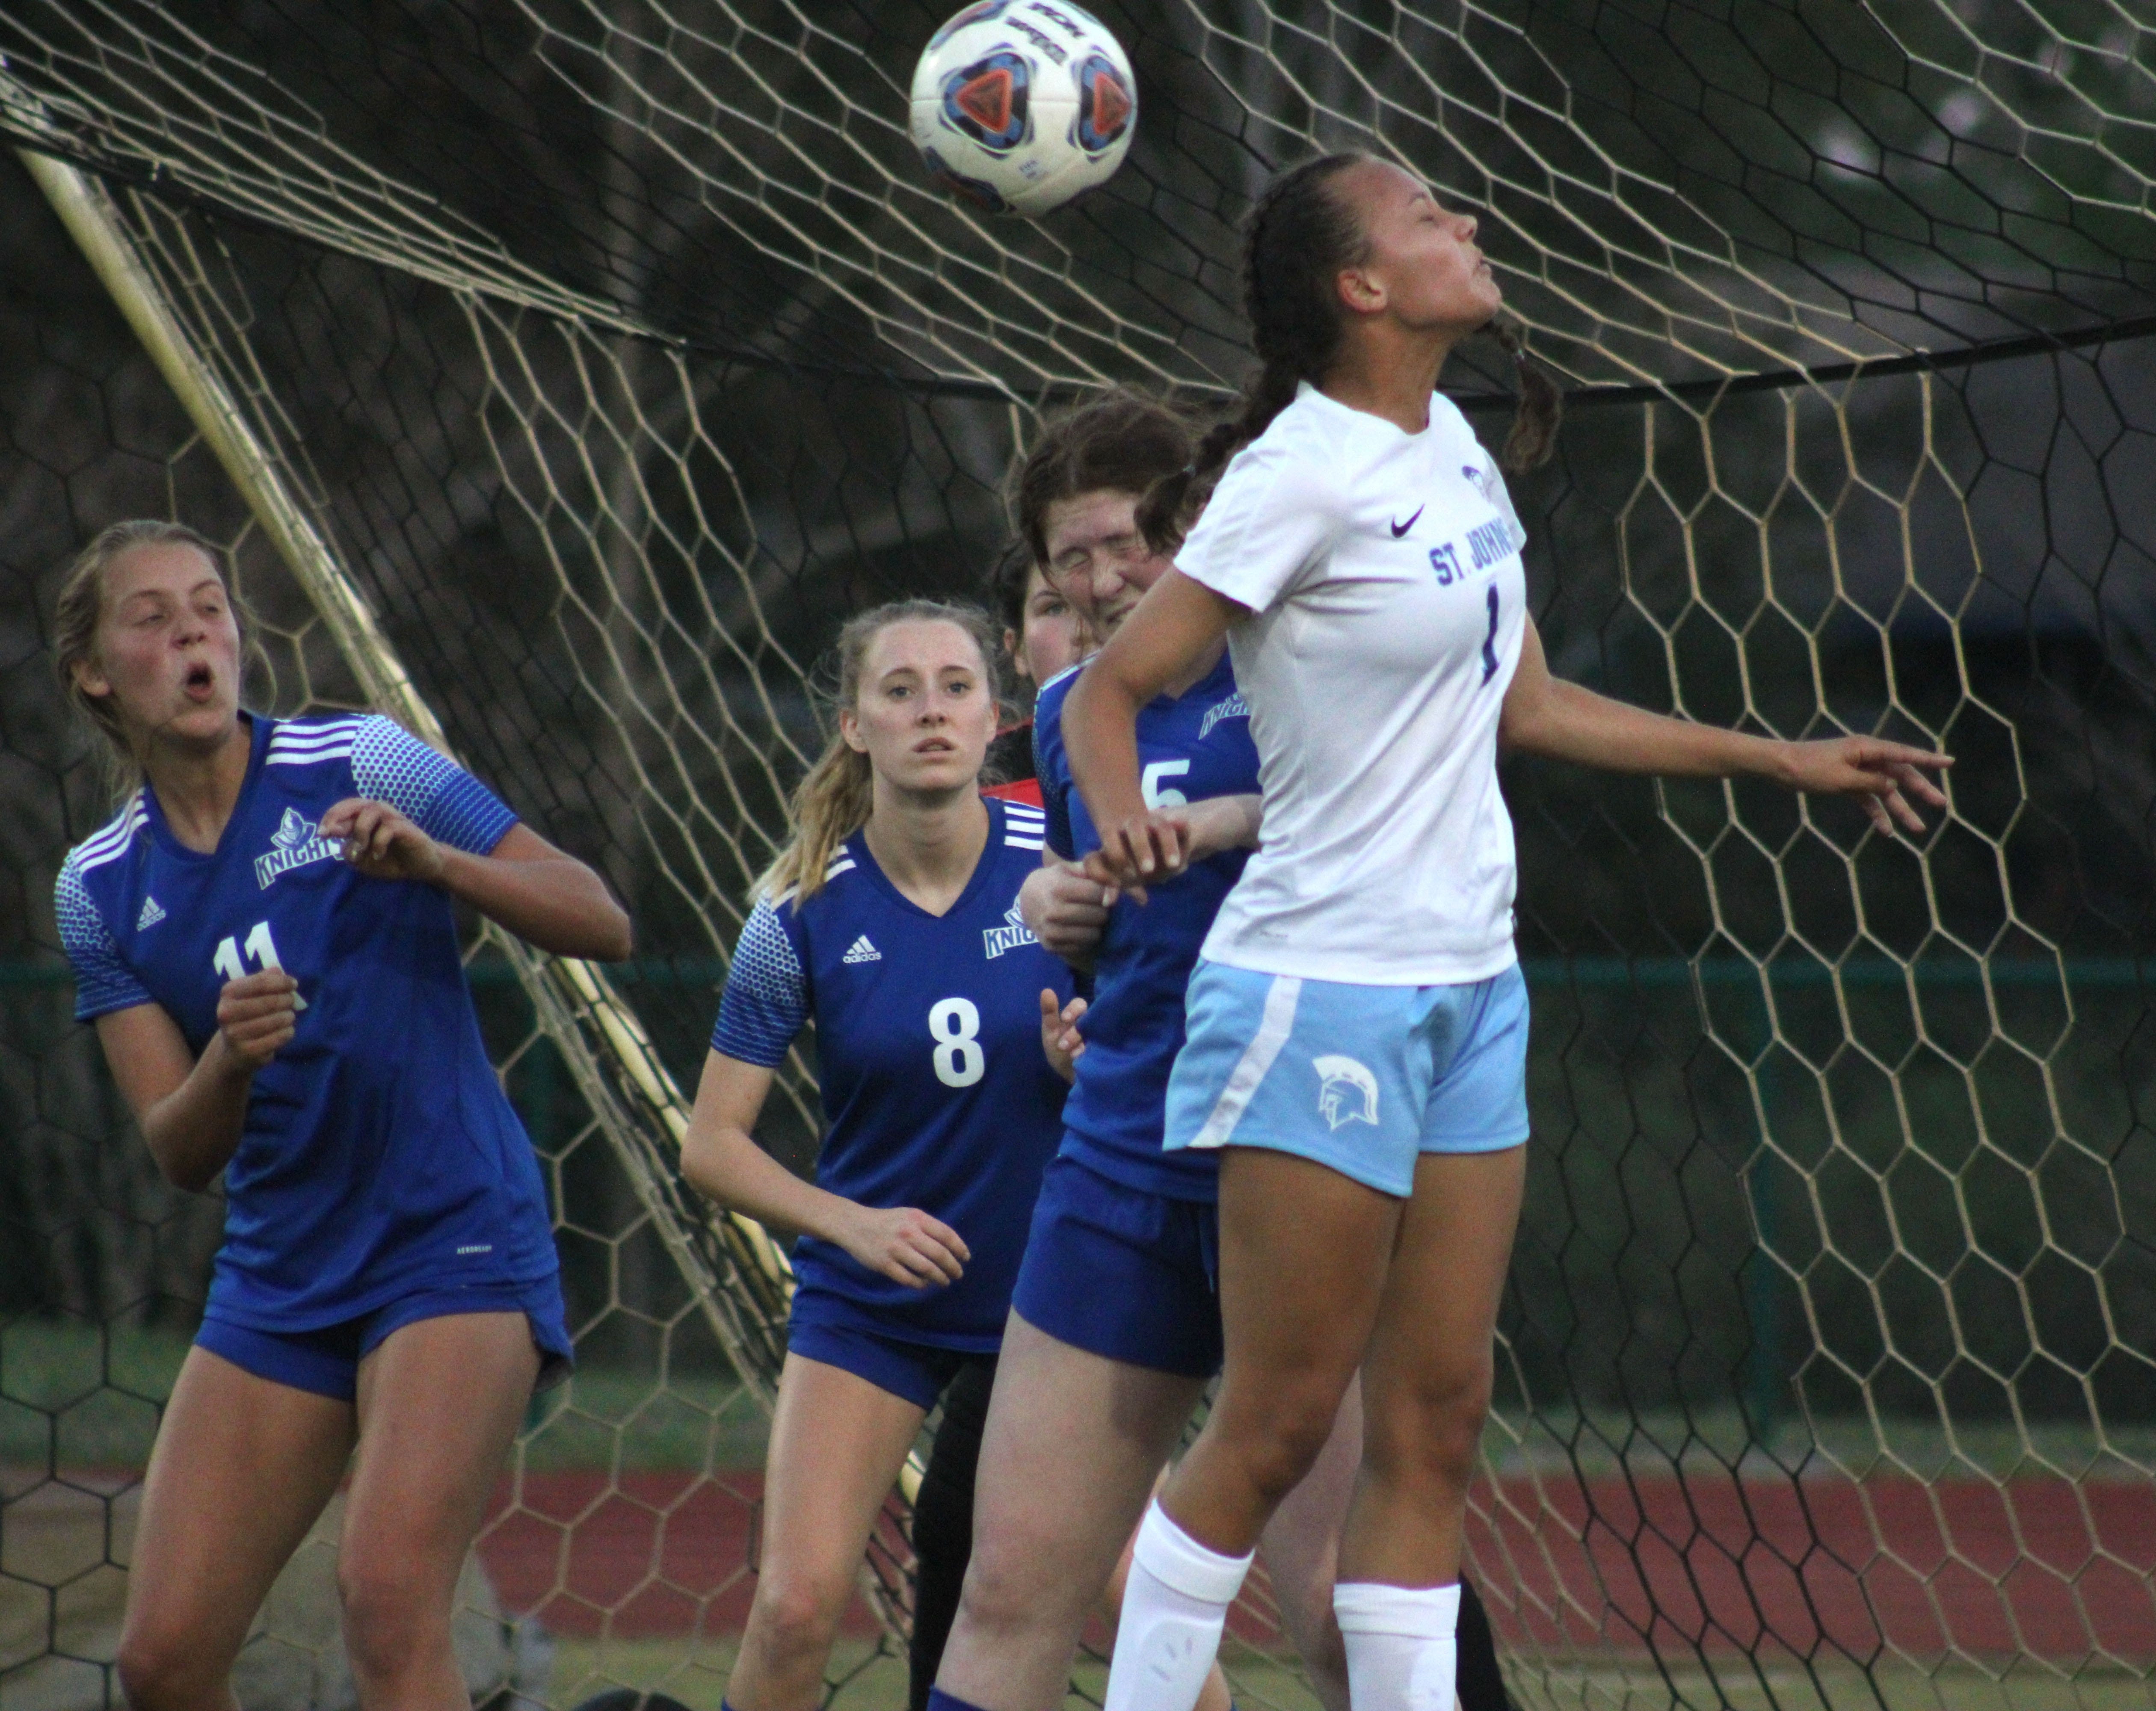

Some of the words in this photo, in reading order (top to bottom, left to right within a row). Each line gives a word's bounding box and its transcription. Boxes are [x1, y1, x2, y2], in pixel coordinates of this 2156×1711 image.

[1481, 582, 1499, 687] 1
[1199, 701, 1251, 740] KNIG
[1141, 759, 1190, 811] 5
[842, 951, 882, 964] adidas
[983, 927, 1040, 960] KNIG
[929, 997, 985, 1088] 8
